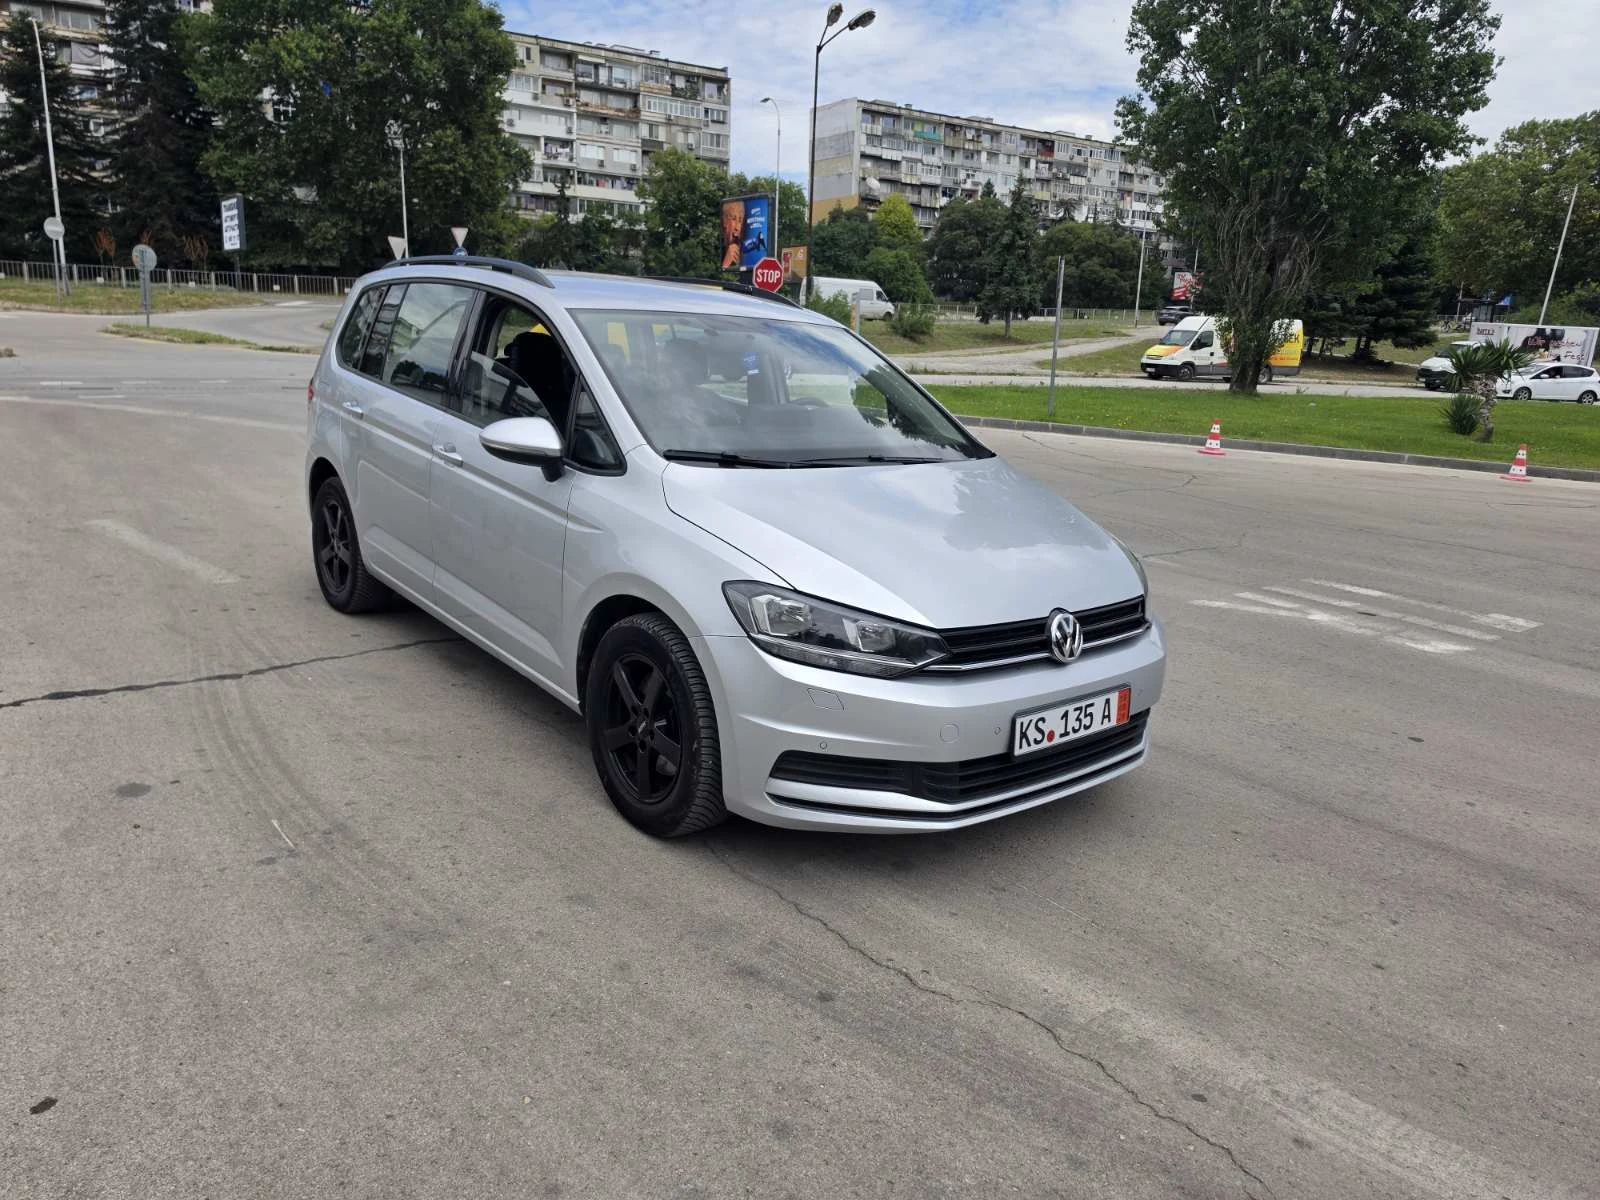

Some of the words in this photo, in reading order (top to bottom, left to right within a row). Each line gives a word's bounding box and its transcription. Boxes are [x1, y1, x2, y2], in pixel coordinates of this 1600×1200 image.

[757, 269, 781, 283] STOP
[1018, 717, 1047, 750] KS
[1059, 702, 1096, 739] 135
[1101, 697, 1112, 726] A
